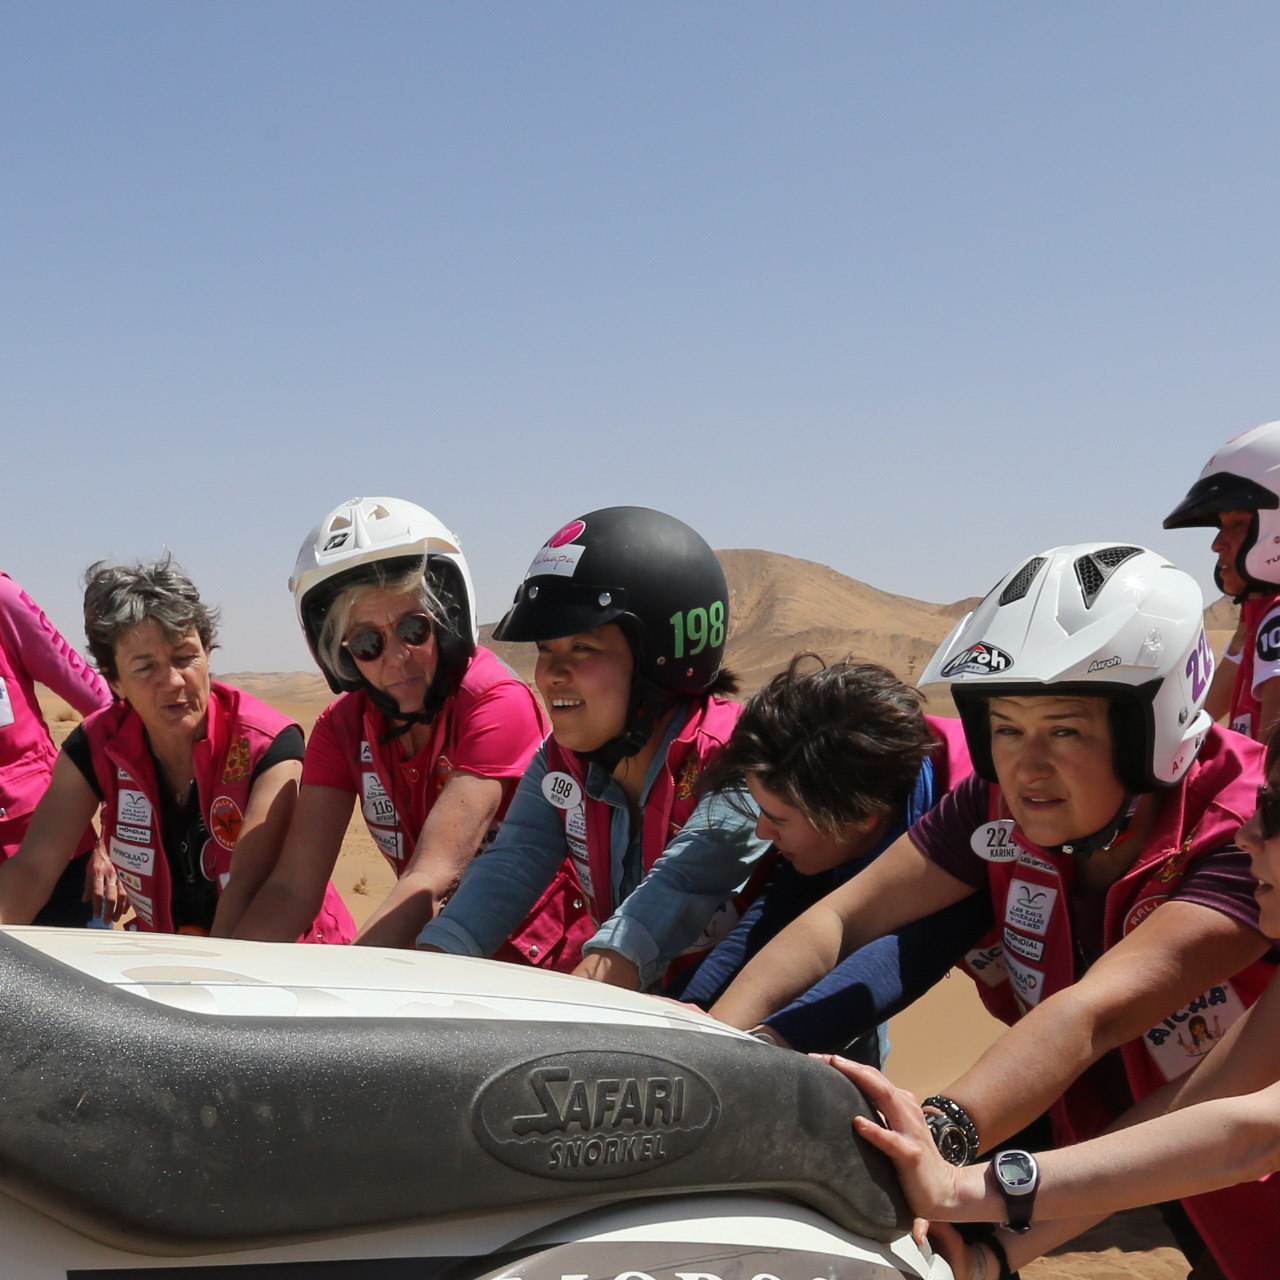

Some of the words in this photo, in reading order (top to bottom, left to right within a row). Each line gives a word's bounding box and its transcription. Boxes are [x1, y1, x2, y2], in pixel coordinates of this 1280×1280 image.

[670, 600, 725, 658] 198
[943, 645, 1005, 673] Airoh
[1088, 656, 1121, 673] Airoh
[551, 776, 573, 798] 198
[372, 800, 393, 815] 116
[990, 848, 1015, 857] KARINE
[1006, 930, 1038, 950] MONDIAL
[971, 946, 1003, 970] AIC
[1147, 985, 1228, 1047] AICHA
[511, 1066, 685, 1136] SAFARI
[548, 1135, 665, 1169] SNORKEL
